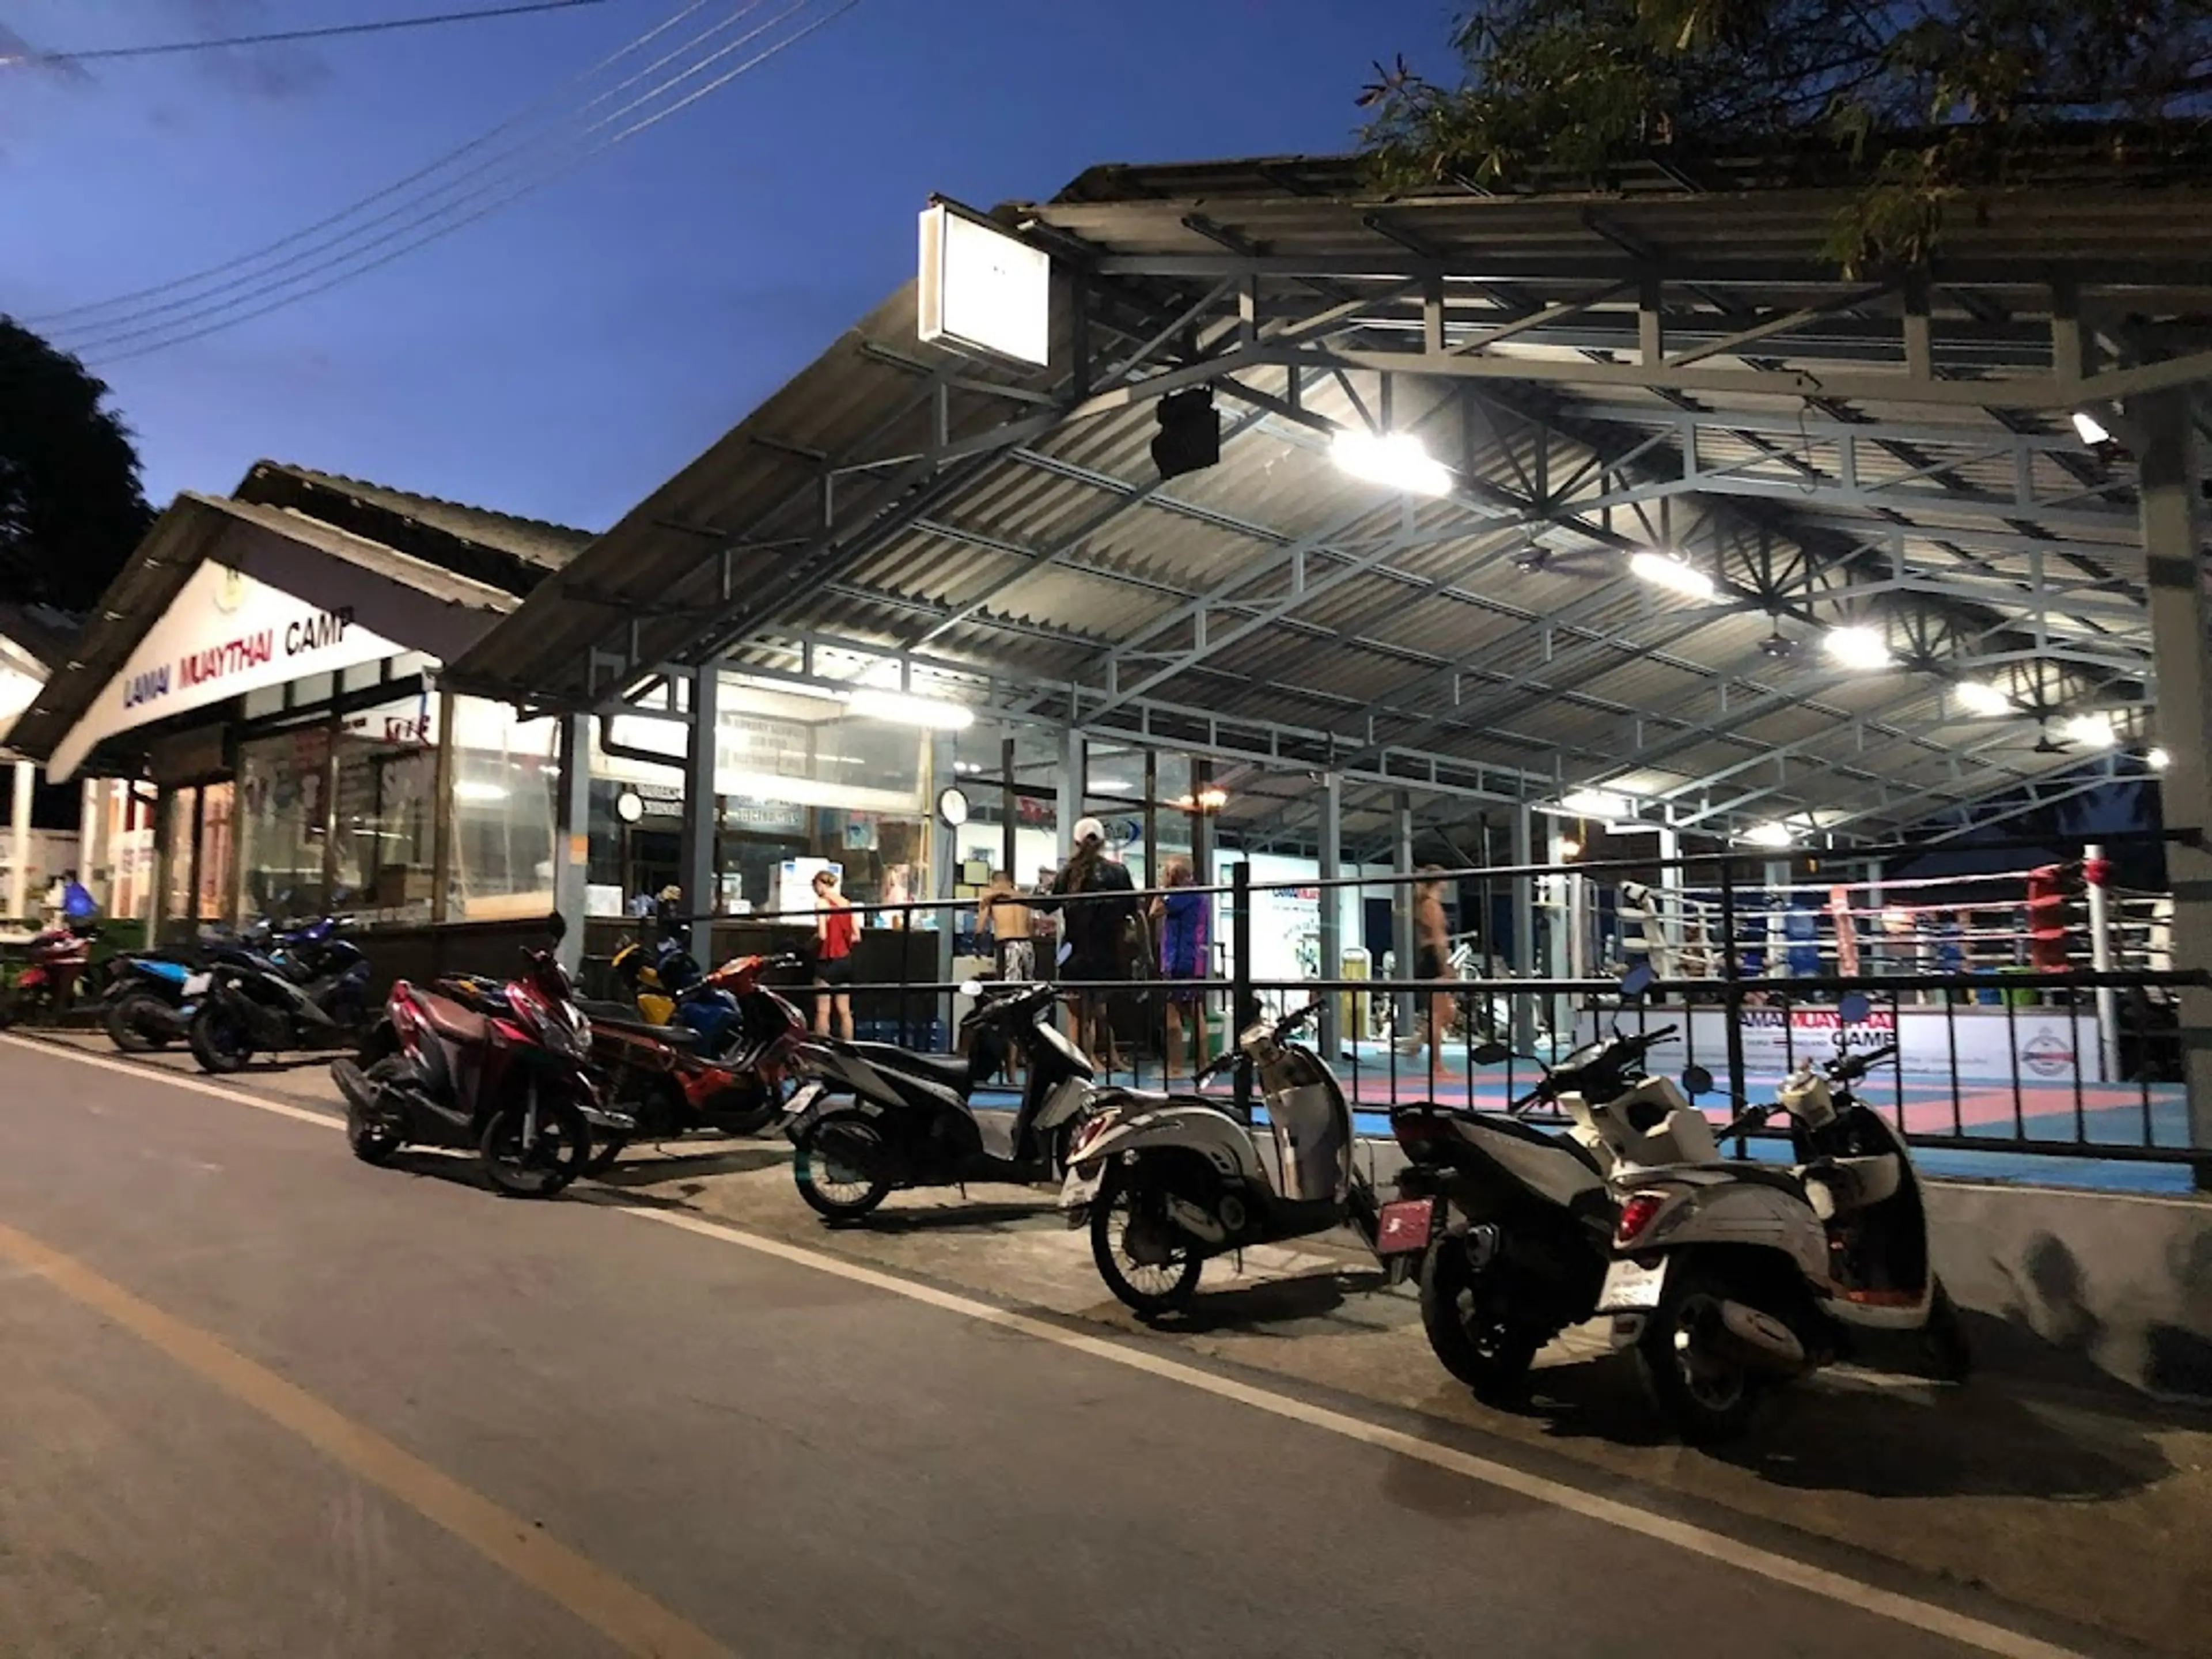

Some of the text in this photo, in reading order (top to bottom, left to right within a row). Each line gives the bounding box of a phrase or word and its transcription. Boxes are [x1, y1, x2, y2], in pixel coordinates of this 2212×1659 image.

[124, 605, 355, 710] LAMAI MUAYTHAI CAMP
